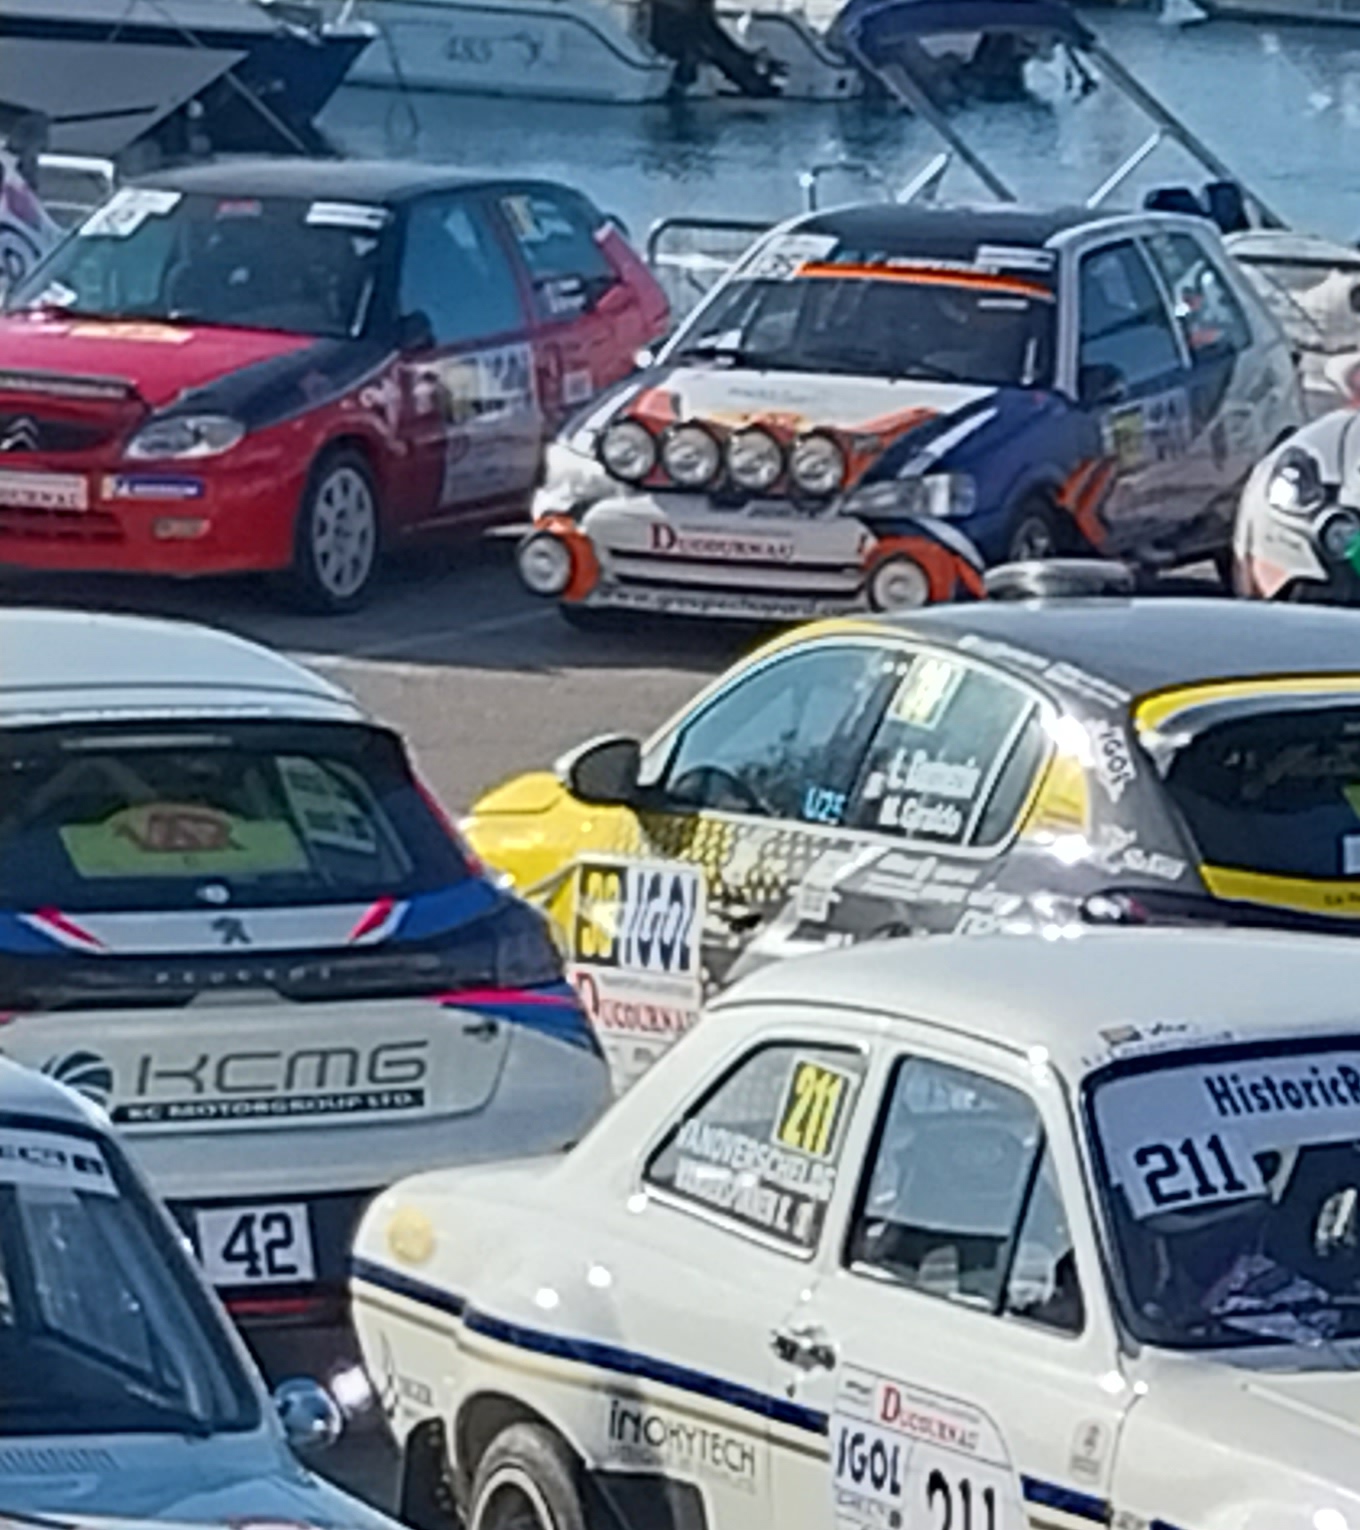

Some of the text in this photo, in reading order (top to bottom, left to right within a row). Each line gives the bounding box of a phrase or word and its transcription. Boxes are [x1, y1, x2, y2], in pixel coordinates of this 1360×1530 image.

[624, 872, 699, 972] IGOL
[136, 1040, 429, 1097] KCMG
[168, 1095, 363, 1118] MOTORGROUP
[781, 1064, 844, 1155] 211
[1132, 1132, 1247, 1208] 211
[221, 1211, 299, 1278] 42
[836, 1426, 902, 1497] IGOL
